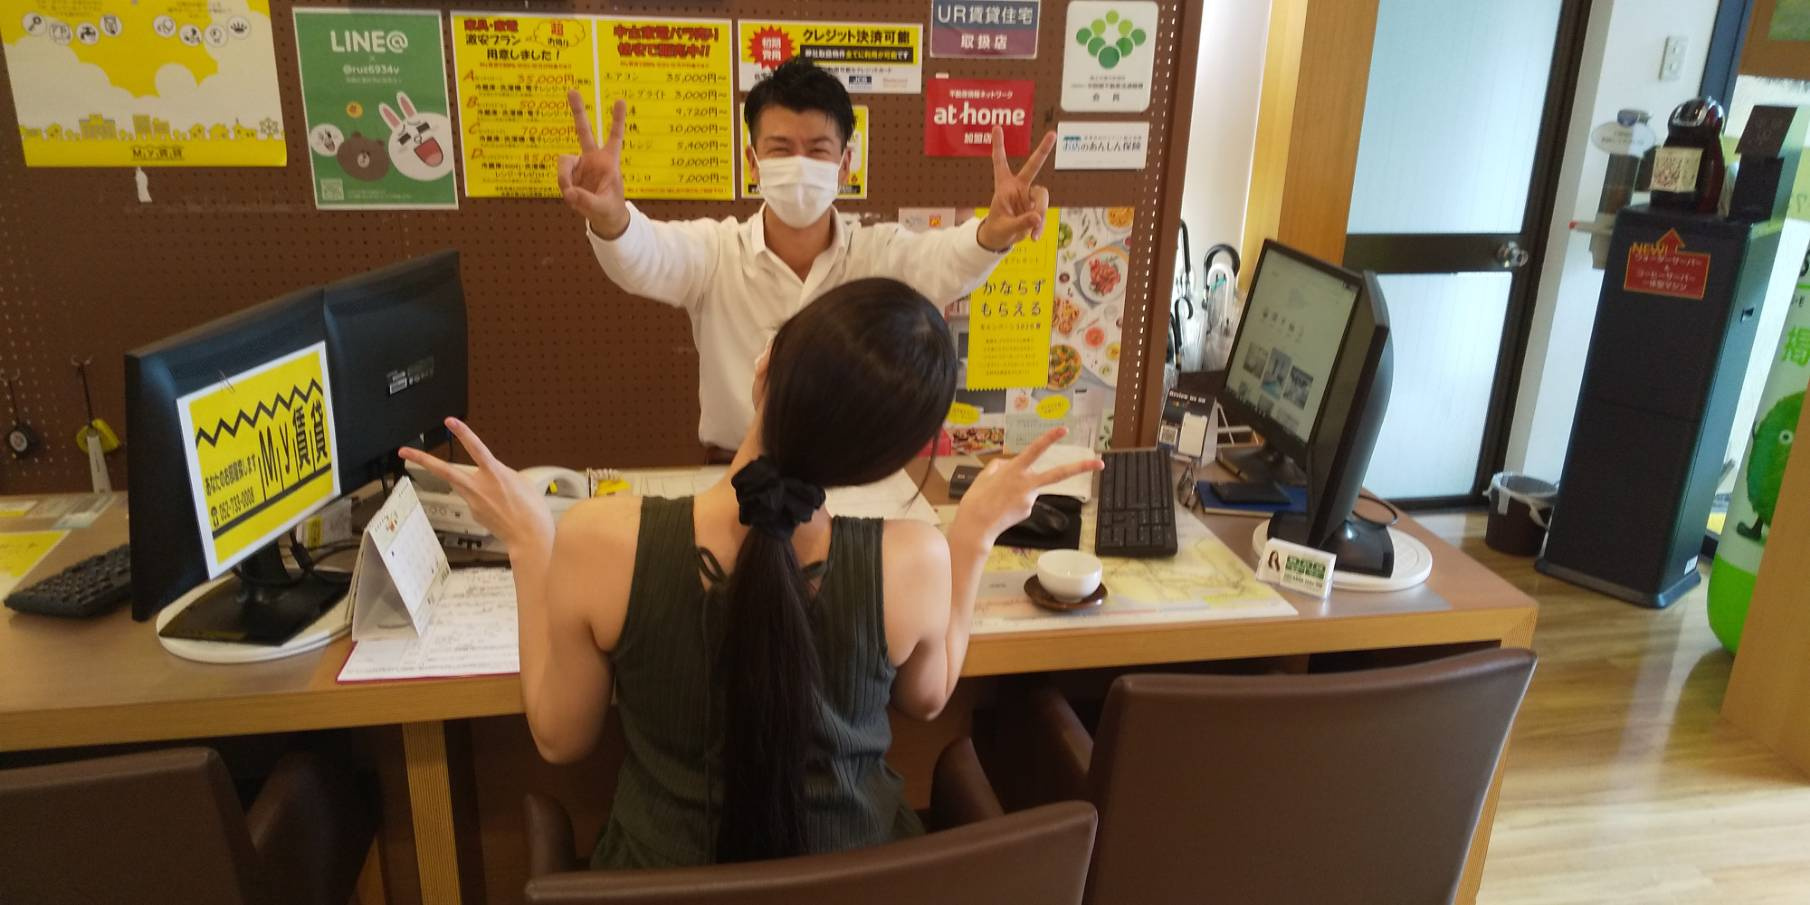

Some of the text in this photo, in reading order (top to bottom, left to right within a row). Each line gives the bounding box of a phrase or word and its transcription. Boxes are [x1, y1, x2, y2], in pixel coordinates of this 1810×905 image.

[937, 5, 1033, 25] UR賃貸住宅
[330, 30, 409, 53] LINE@
[466, 34, 521, 45] 激安プラン
[803, 28, 910, 44] クレジット決済可能
[961, 34, 1008, 50] 取扱店
[983, 279, 1046, 296] かならず
[981, 301, 1041, 317] もらえる
[258, 400, 328, 489] My賃貸
